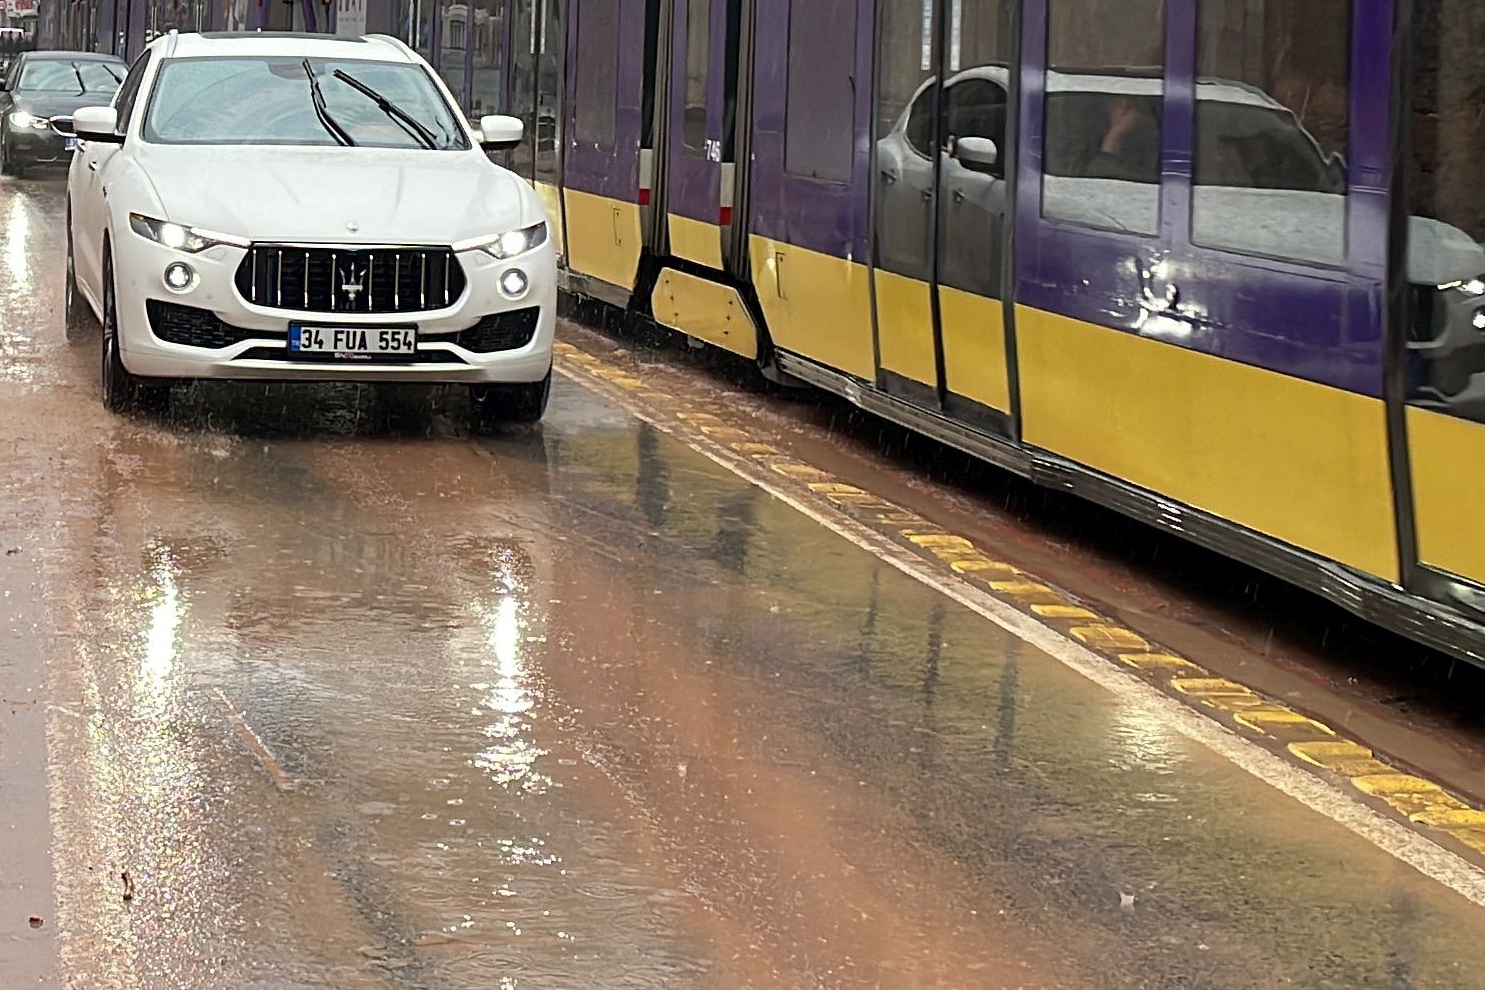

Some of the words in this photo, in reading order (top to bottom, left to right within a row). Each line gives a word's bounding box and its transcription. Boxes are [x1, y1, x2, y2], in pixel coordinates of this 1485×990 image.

[302, 329, 323, 349] 34
[333, 330, 367, 350] FUA
[379, 331, 412, 350] 554
